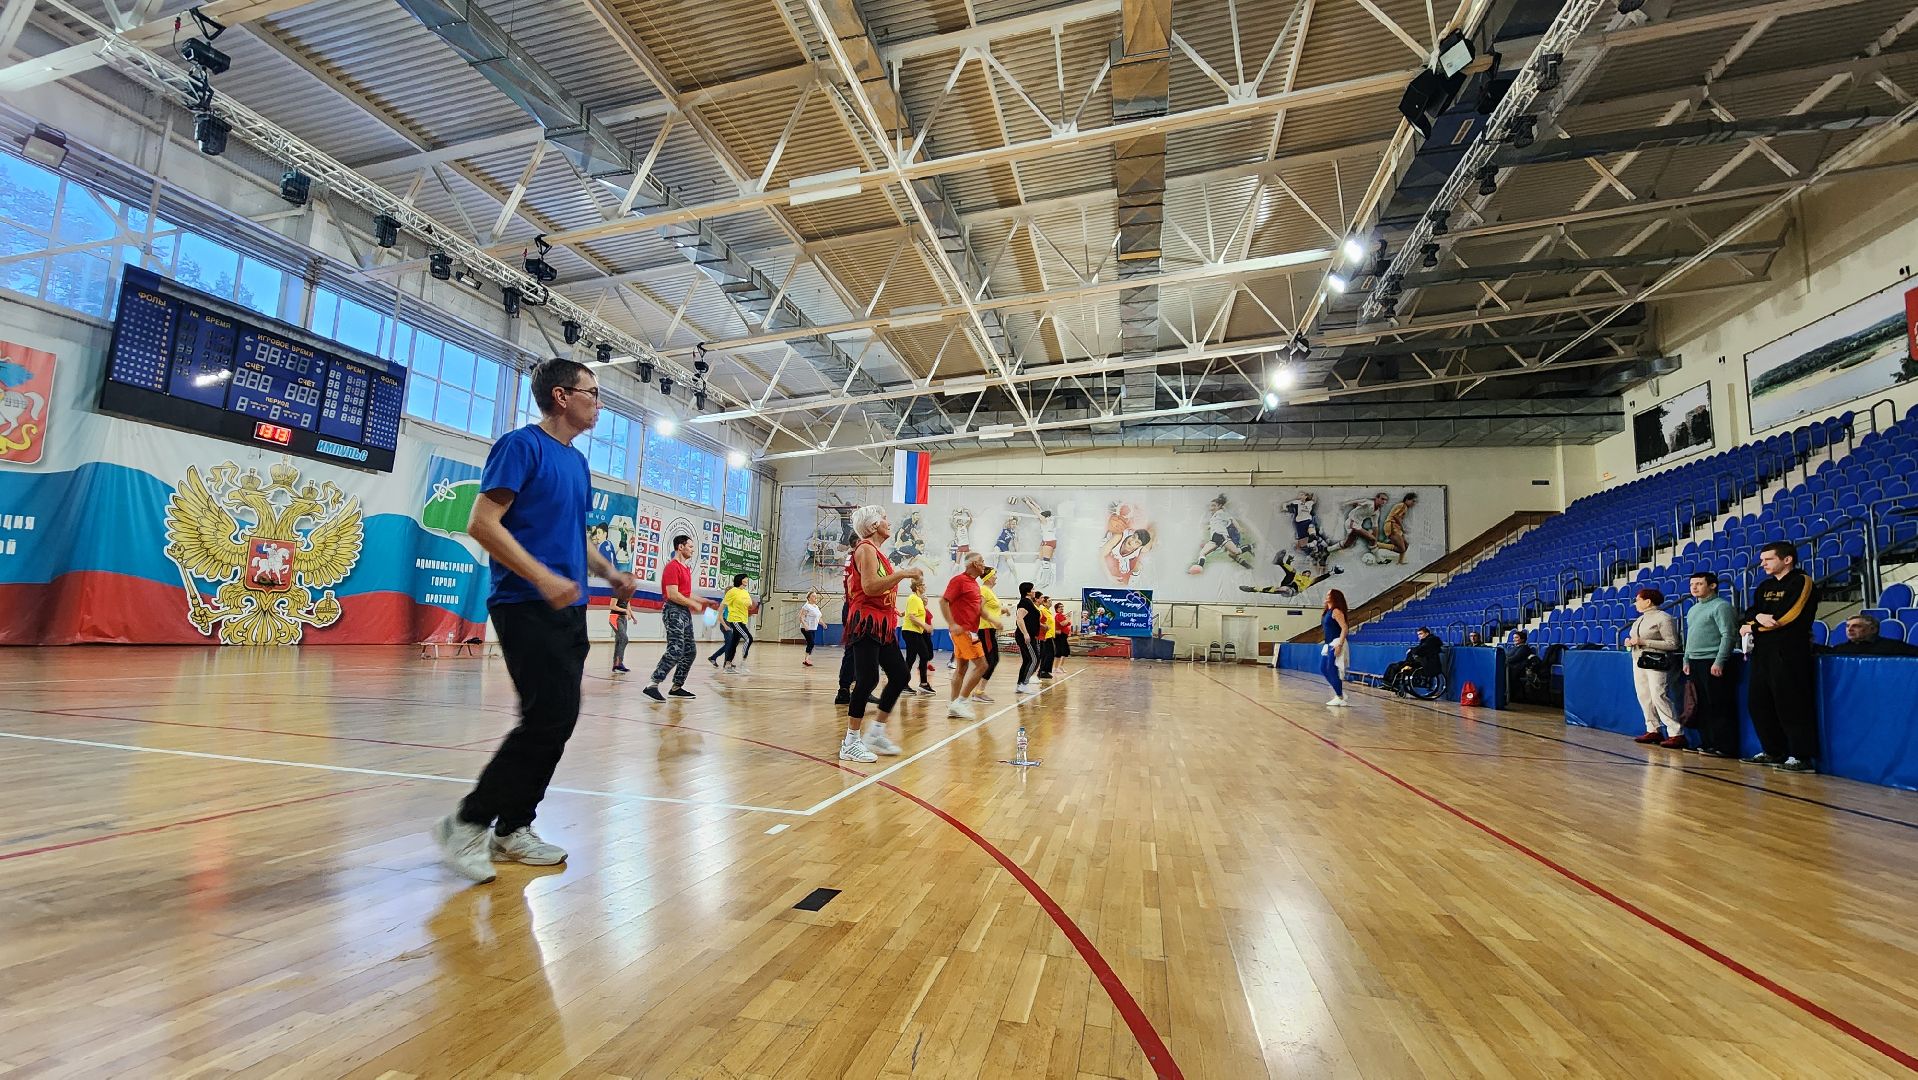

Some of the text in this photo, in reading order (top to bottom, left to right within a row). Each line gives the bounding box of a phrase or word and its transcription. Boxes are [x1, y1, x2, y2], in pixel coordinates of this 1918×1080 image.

[138, 292, 166, 306] ФОЛЫ
[205, 315, 231, 329] ВРЕМЯ
[257, 334, 314, 358] ИГРОВОЕ ВРЕМЯ
[346, 363, 366, 375] ВРЕМЯ
[380, 375, 398, 387] ФОЛЫ
[265, 396, 290, 408] ПЕРИОД
[316, 440, 369, 462] ИМПУЛЬС
[0, 513, 36, 531] ЦИЯ
[415, 558, 474, 574] АДМИНИСТРАЦИЯ
[431, 576, 456, 588] ГОРОДА
[425, 593, 459, 605] ПРОТВИНО
